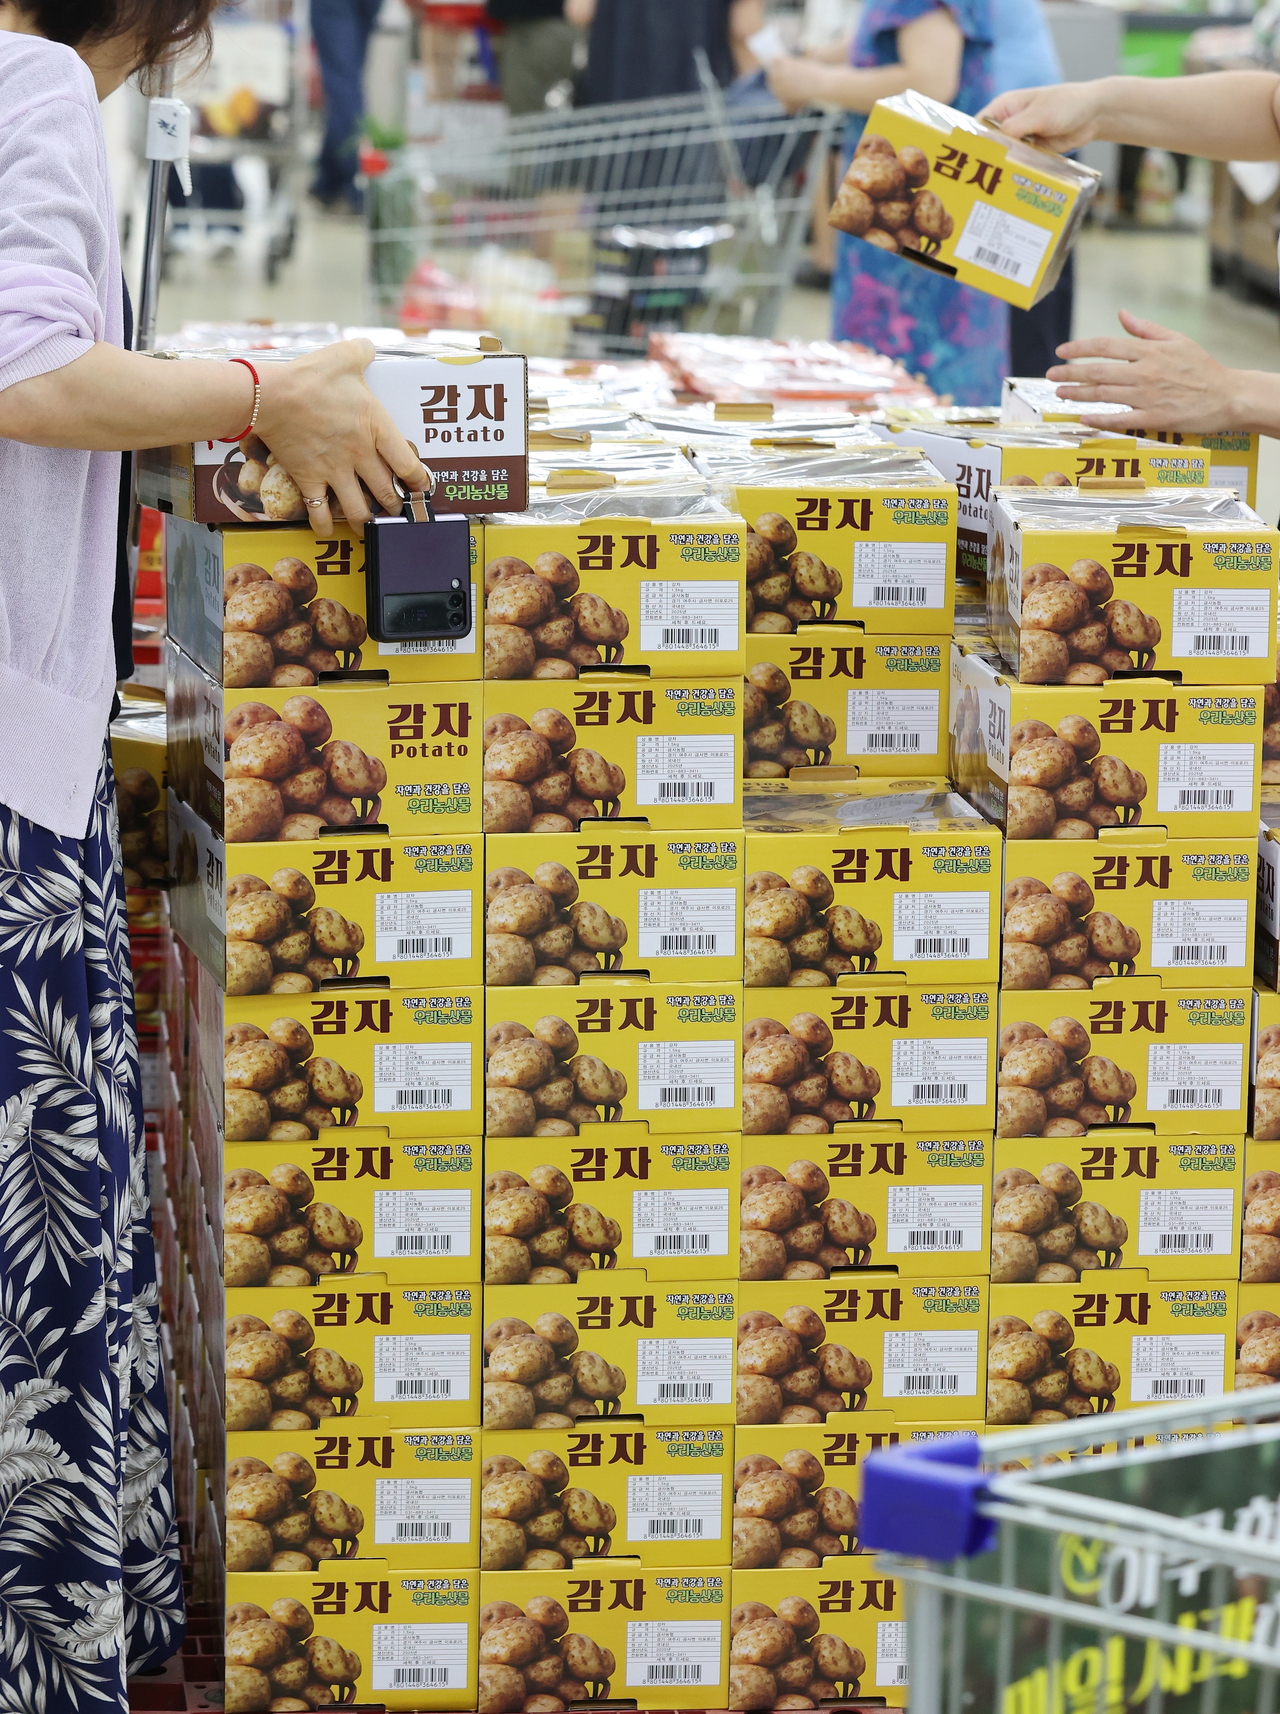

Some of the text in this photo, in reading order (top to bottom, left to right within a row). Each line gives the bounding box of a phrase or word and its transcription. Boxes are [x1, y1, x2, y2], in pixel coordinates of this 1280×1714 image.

[933, 144, 1003, 196] 감자
[420, 384, 508, 424] 감자
[425, 426, 504, 443] Potato
[462, 469, 488, 482] 건강을
[492, 468, 509, 481] 담은
[956, 463, 992, 502] 감자
[1157, 470, 1205, 485] 우리농산물
[445, 483, 509, 501] 우리농산물
[882, 498, 948, 509] 자연과 건강을 담은
[795, 497, 873, 532] 감자
[893, 510, 948, 526] 우리농산물
[670, 534, 739, 545] 자연과 건강을 담은
[577, 535, 660, 570] 감자
[681, 547, 740, 562] 우리농산물
[1203, 543, 1272, 554] 자연과 건강을 담은
[315, 540, 366, 575] 감
[1111, 542, 1193, 578] 감자
[1214, 555, 1272, 571] 우리농산물
[789, 646, 866, 679] 감자
[886, 658, 941, 672] 우리농산물
[665, 688, 735, 700] 자연과 건강을 담은
[573, 690, 655, 726] 감자
[677, 701, 735, 717] 우리농산물
[1098, 698, 1179, 733] 감자
[386, 702, 472, 740] 감자
[988, 698, 1006, 746] 감자
[1199, 710, 1256, 725] 우리농산물
[391, 742, 468, 758] Potato
[395, 782, 470, 797] 자연과 건강을 담은
[407, 797, 471, 814] 우리농산물
[404, 844, 472, 857] 자연과 건강을 담은
[922, 846, 990, 857] 자연과 건강을 담은
[313, 847, 394, 885] 감자
[415, 856, 473, 873] 우리농산물
[576, 844, 658, 879] 감자
[679, 855, 737, 870] 우리농산물
[832, 847, 912, 883] 감자
[933, 858, 991, 874] 우리농산물
[1092, 855, 1172, 890] 감자
[1192, 867, 1249, 882] 우리농산물
[402, 997, 472, 1008] 자연과 건강을 담은
[921, 993, 988, 1004] 자연과 건강을 담은
[311, 999, 393, 1035] 감자
[414, 1009, 472, 1025] 우리농산물
[576, 997, 657, 1033] 감자
[678, 1007, 736, 1023] 우리농산물
[831, 995, 911, 1030] 감자
[932, 1005, 989, 1021] 우리농산물
[1088, 1000, 1168, 1034] 감자
[1188, 1011, 1245, 1026] 우리농산물
[403, 1145, 472, 1155] 자연과 건강을 담은
[917, 1140, 984, 1151] 자연과 건강을 담은
[312, 1146, 393, 1181] 감자
[414, 1157, 472, 1172] 우리농산물
[571, 1146, 651, 1182] 감자
[672, 1156, 729, 1172] 우리농산물
[827, 1142, 907, 1177] 감자
[927, 1152, 984, 1168] 우리농산물
[1080, 1146, 1159, 1180] 감자
[1179, 1156, 1236, 1171] 우리농산물
[403, 1290, 471, 1301] 자연과 건강을 담은
[912, 1286, 979, 1297] 자연과 건강을 담은
[312, 1292, 393, 1326] 감자
[414, 1302, 471, 1317] 우리농산물
[576, 1295, 656, 1329] 감자
[823, 1288, 903, 1322] 감자
[923, 1298, 980, 1313] 우리농산물
[1072, 1292, 1151, 1327] 감자
[1171, 1302, 1227, 1317] 우리농산물
[677, 1306, 734, 1321] 우리농산물
[404, 1435, 472, 1445] 자연과 건강을 담은
[911, 1431, 934, 1441] 자연과
[314, 1436, 395, 1469] 감자
[415, 1447, 473, 1461] 우리농산물
[567, 1432, 646, 1466] 감자
[667, 1442, 724, 1458] 우리농산물
[312, 1581, 391, 1615] 감자
[412, 1591, 469, 1606] 우리농산물
[567, 1578, 646, 1612] 감자
[666, 1589, 723, 1604] 우리농산물
[817, 1579, 896, 1613] 감자
